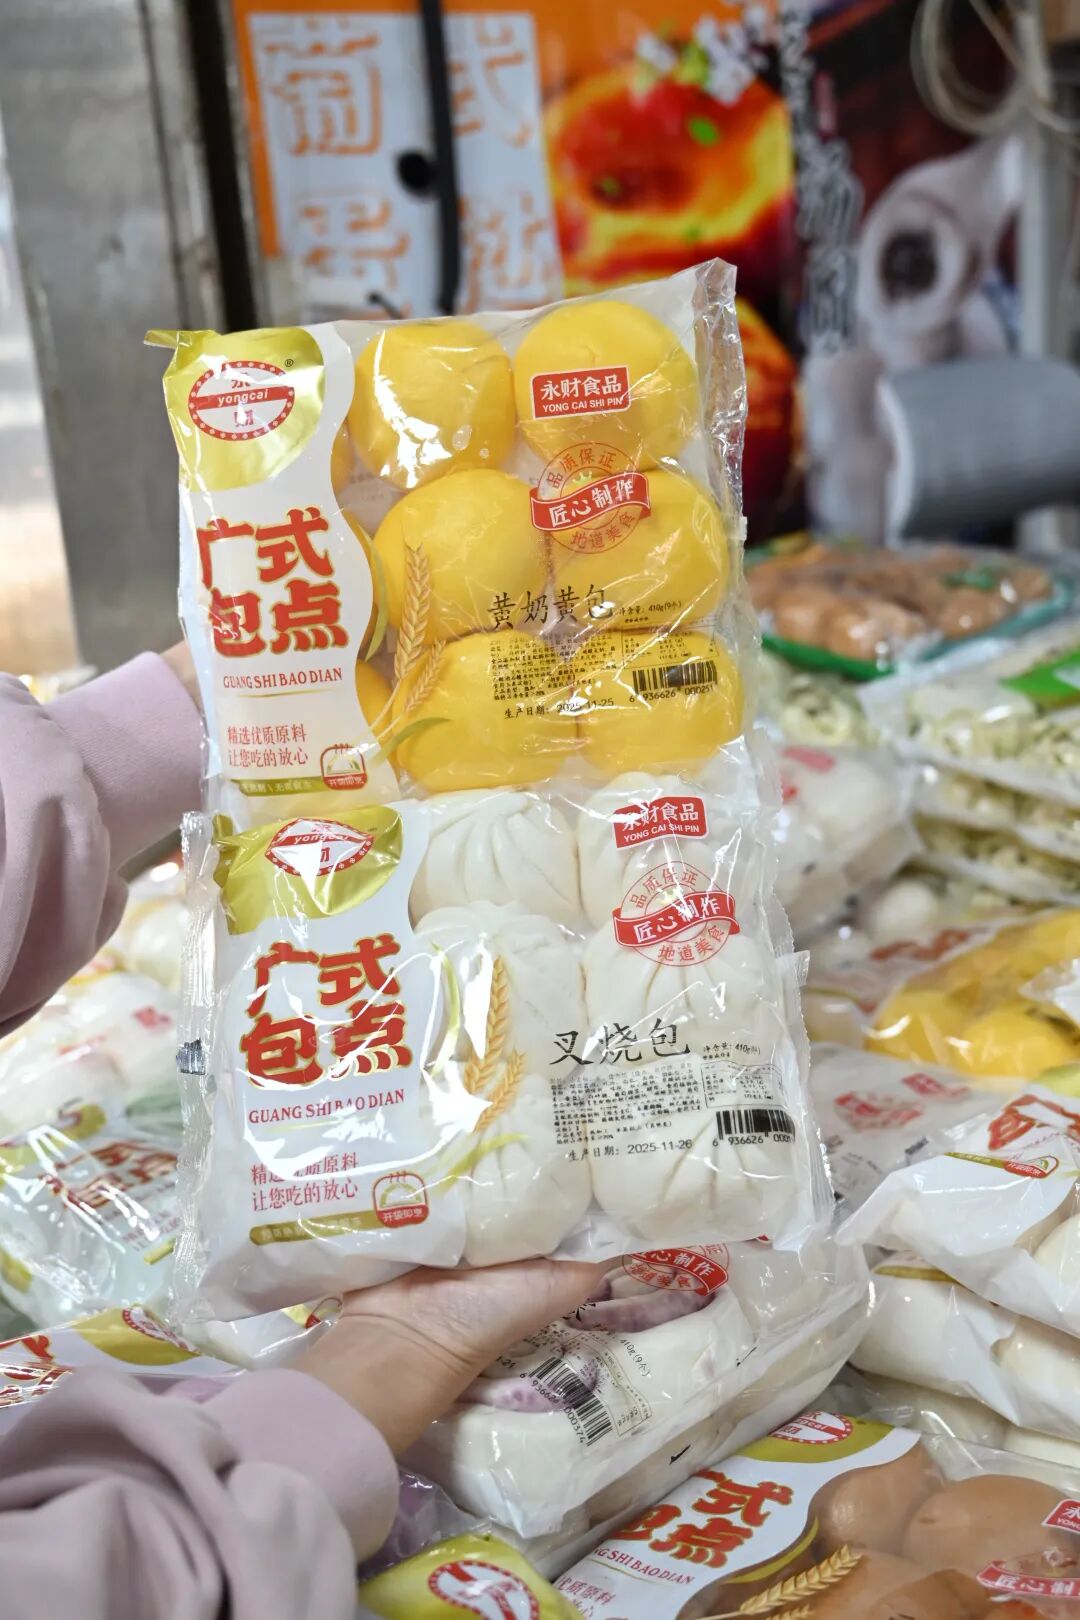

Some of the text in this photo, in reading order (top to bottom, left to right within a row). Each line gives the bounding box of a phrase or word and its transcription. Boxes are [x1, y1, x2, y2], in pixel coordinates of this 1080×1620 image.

[217, 389, 269, 407] yongcai
[540, 374, 622, 401] 永财食品
[542, 397, 622, 413] YONG CAI SHI PIN
[547, 447, 617, 489] 品质保证
[548, 478, 634, 528] 匠心制作
[196, 506, 335, 589] 广式
[208, 578, 350, 658] 包点
[223, 668, 343, 689] GUANG SHI BAO DIAN
[227, 723, 306, 745] 精选优质原料
[228, 748, 308, 768] 让您吃的放心
[624, 823, 699, 843] YONG CAI SHI PIN
[630, 867, 699, 909] 品质保证
[658, 925, 725, 961] 地道美食
[247, 933, 402, 1018] 广式
[240, 999, 413, 1088] 包点
[550, 1018, 691, 1065] 叉烧包
[249, 1106, 302, 1124] GUANG
[306, 1102, 332, 1118] SHI
[368, 1089, 405, 1109] DIAN
[627, 1138, 693, 1155] 2025-11-26
[712, 1138, 719, 1147] 6
[728, 1135, 764, 1145] 936626
[252, 1179, 359, 1211] 让您吃的放心
[640, 1250, 715, 1276] 心制作
[607, 1550, 633, 1566] SHI
[630, 1559, 660, 1577] BAO
[658, 1570, 695, 1585] DIAN
